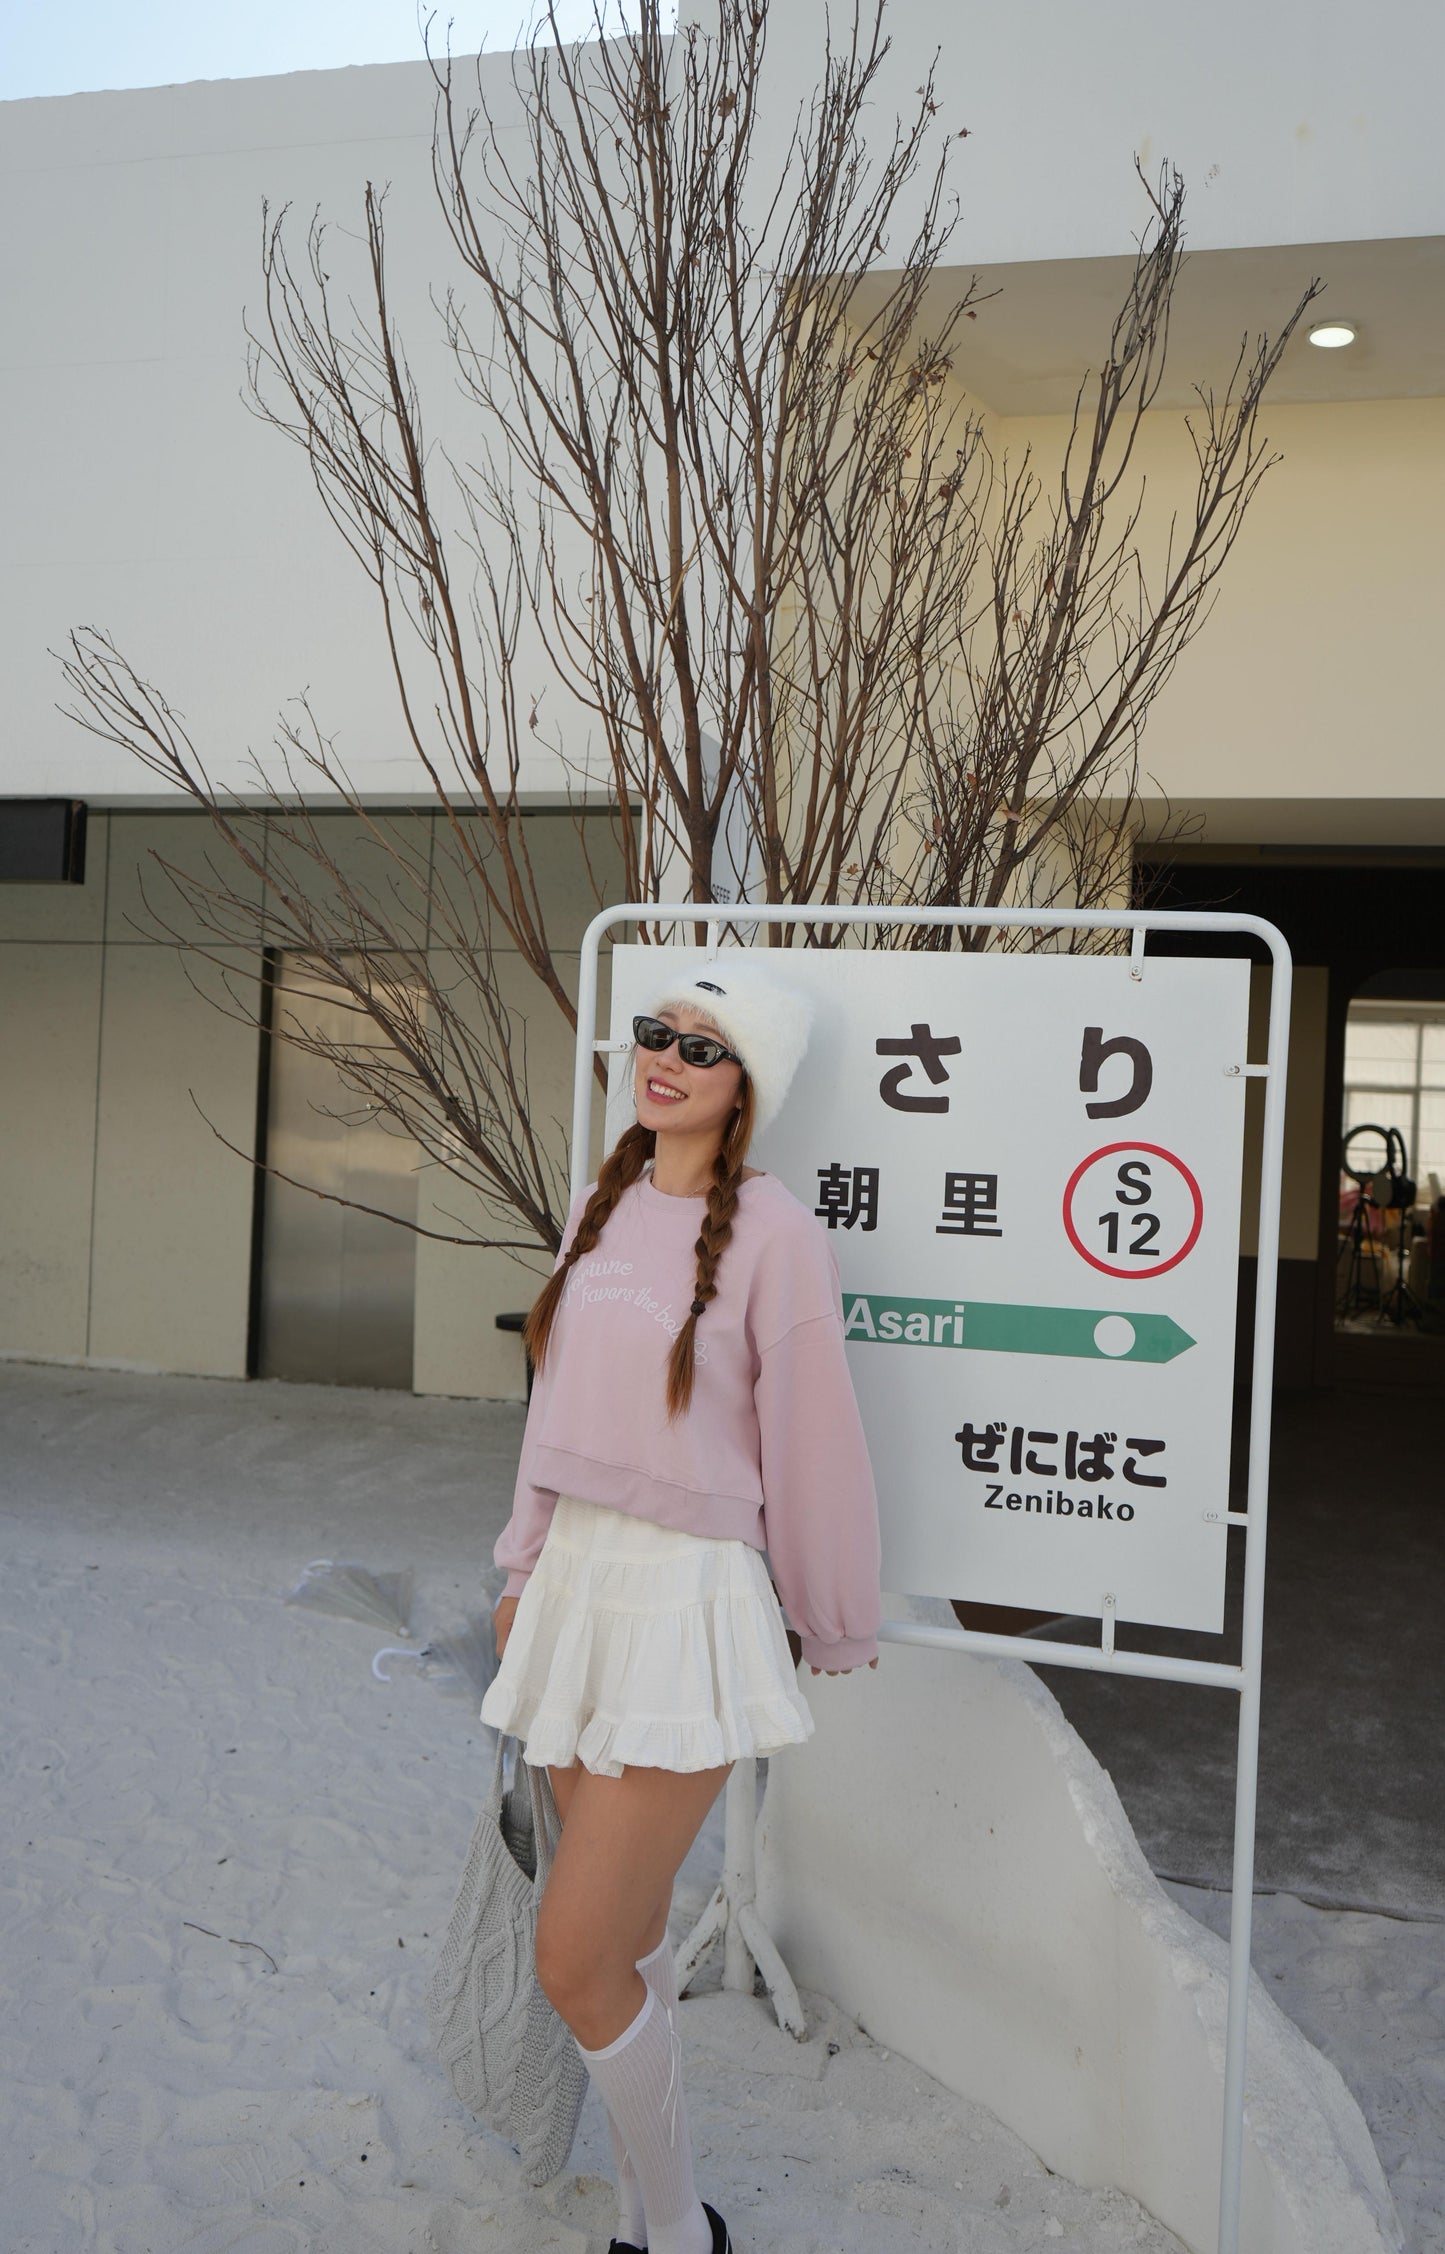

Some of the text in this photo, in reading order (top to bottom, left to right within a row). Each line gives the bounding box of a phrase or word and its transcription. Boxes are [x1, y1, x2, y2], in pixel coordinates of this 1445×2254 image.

[1115, 1161, 1152, 1206] S
[1098, 1211, 1161, 1257] 12
[578, 1284, 635, 1311] favors
[633, 1287, 659, 1314] the
[844, 1298, 965, 1345] Asari
[955, 1422, 1167, 1488] ぜにばこ
[984, 1484, 1135, 1522] Zenibako
